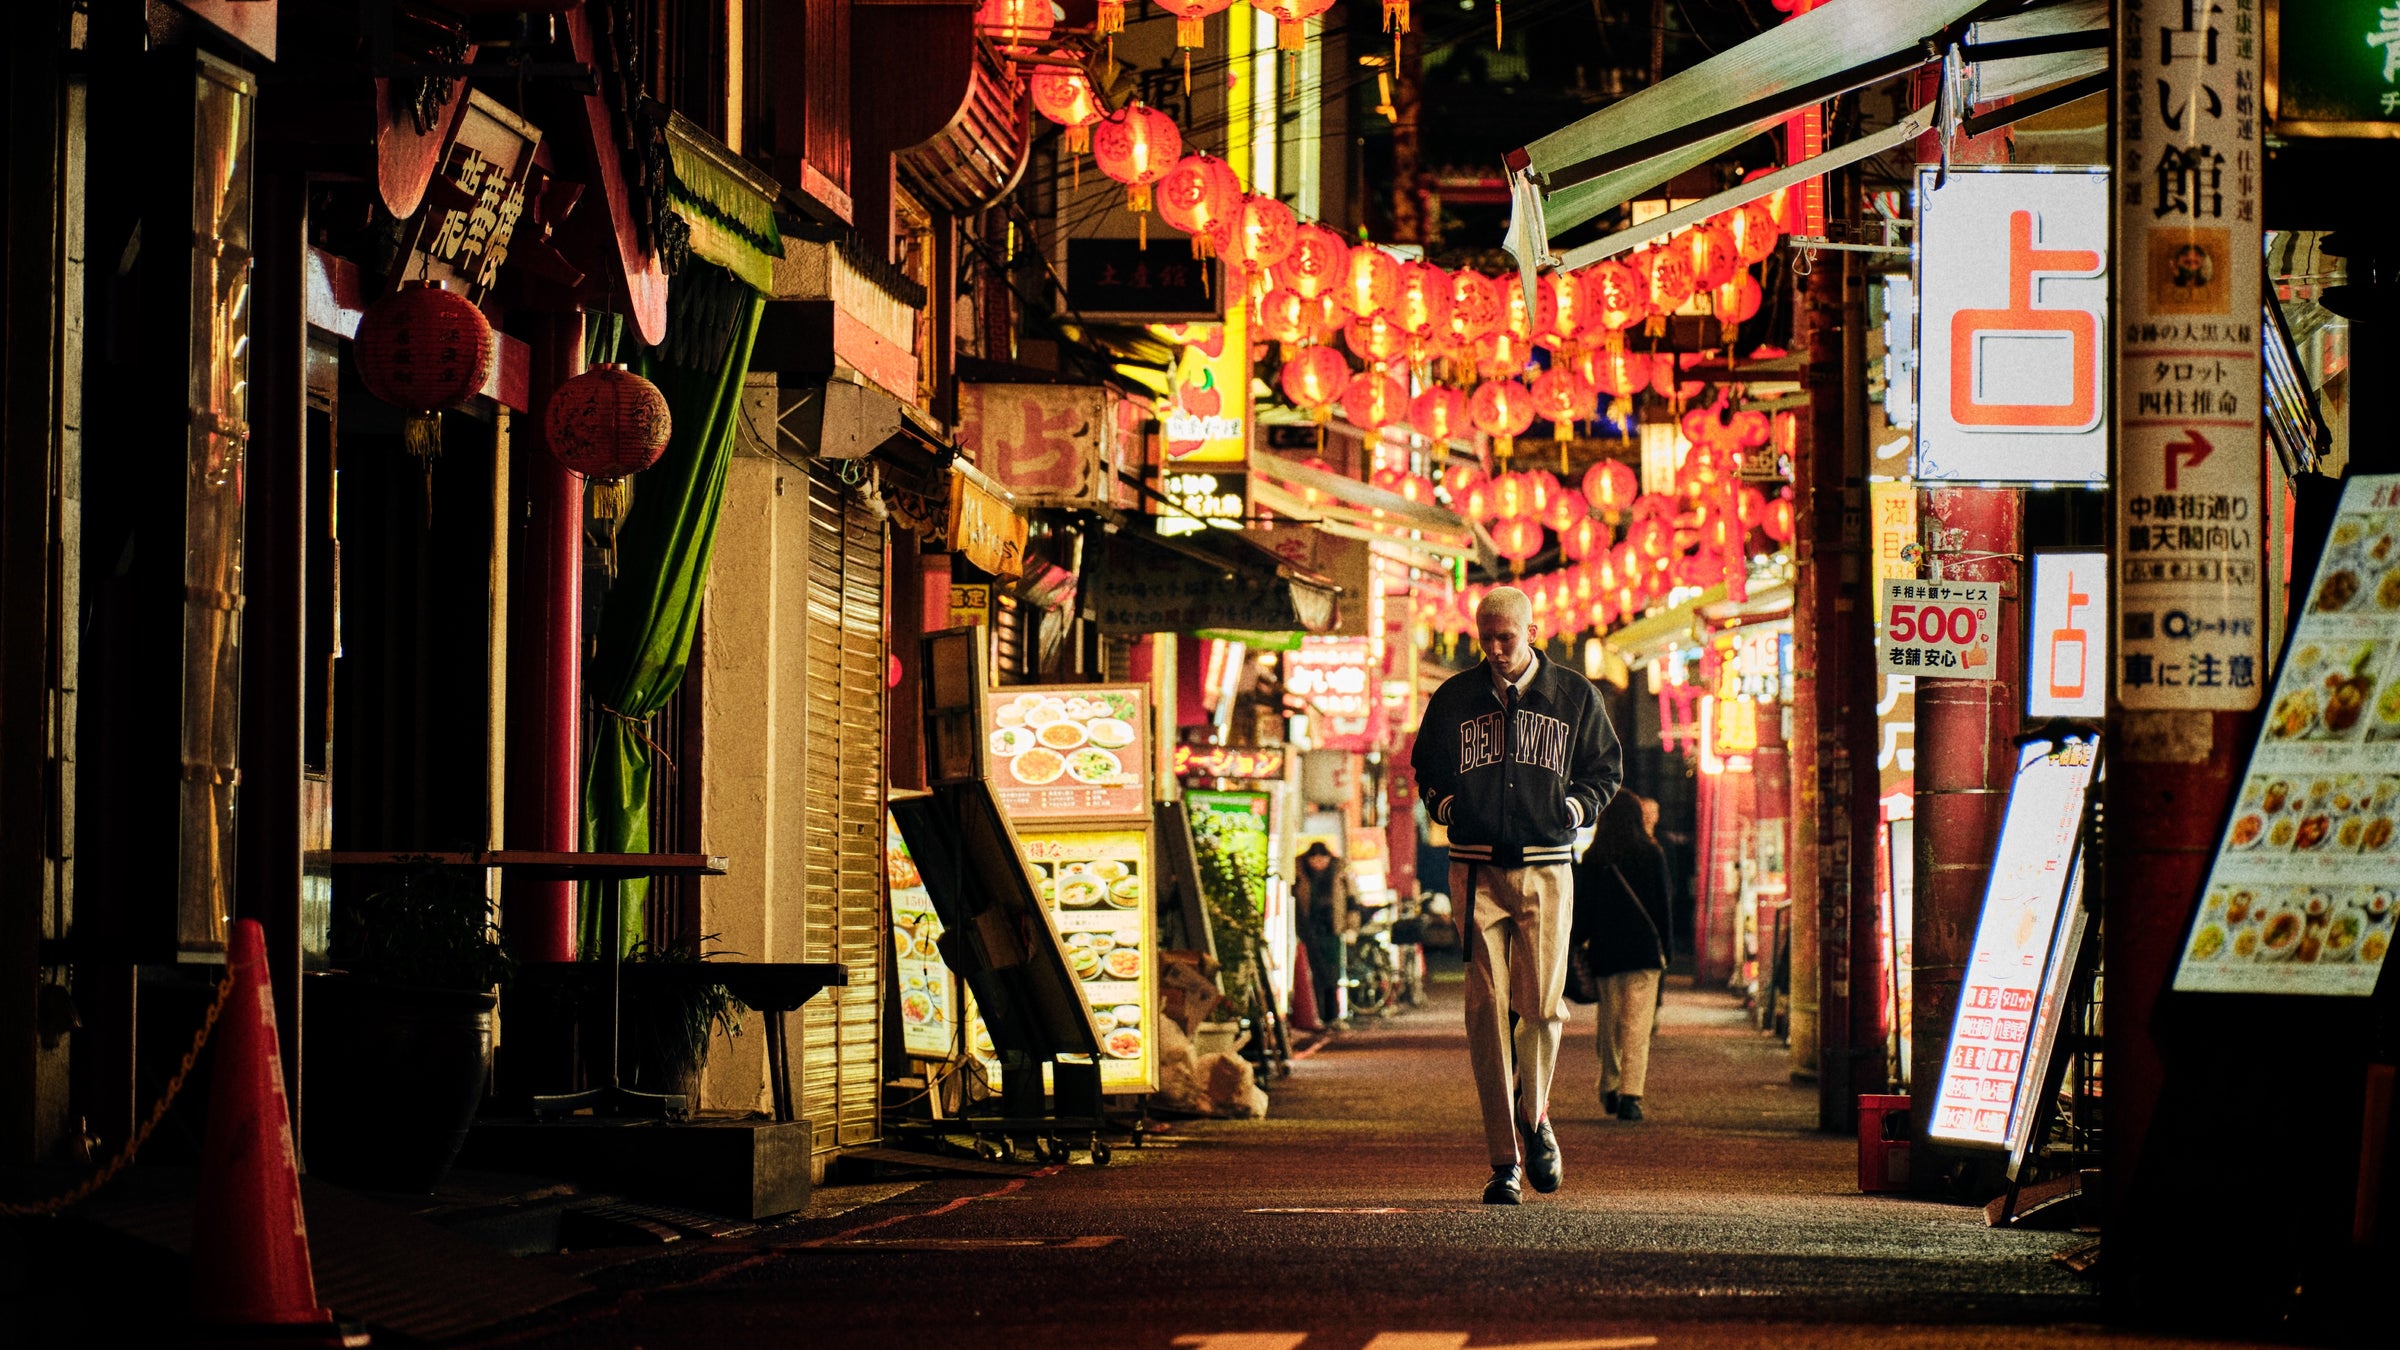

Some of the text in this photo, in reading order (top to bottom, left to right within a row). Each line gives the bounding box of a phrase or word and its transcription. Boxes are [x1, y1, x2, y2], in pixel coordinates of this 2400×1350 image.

[2153, 0, 2226, 218] 占い館
[1951, 209, 2100, 426] 占
[2154, 360, 2228, 383] タロット
[2129, 494, 2249, 521] 中華街通り
[1892, 585, 1988, 601] 手相半額サービス
[1889, 604, 1977, 645] 500
[2051, 570, 2090, 699] 占
[1889, 647, 1957, 668] 老舗 安心
[2124, 653, 2254, 689] 車に注意
[2002, 991, 2033, 1010] タロット
